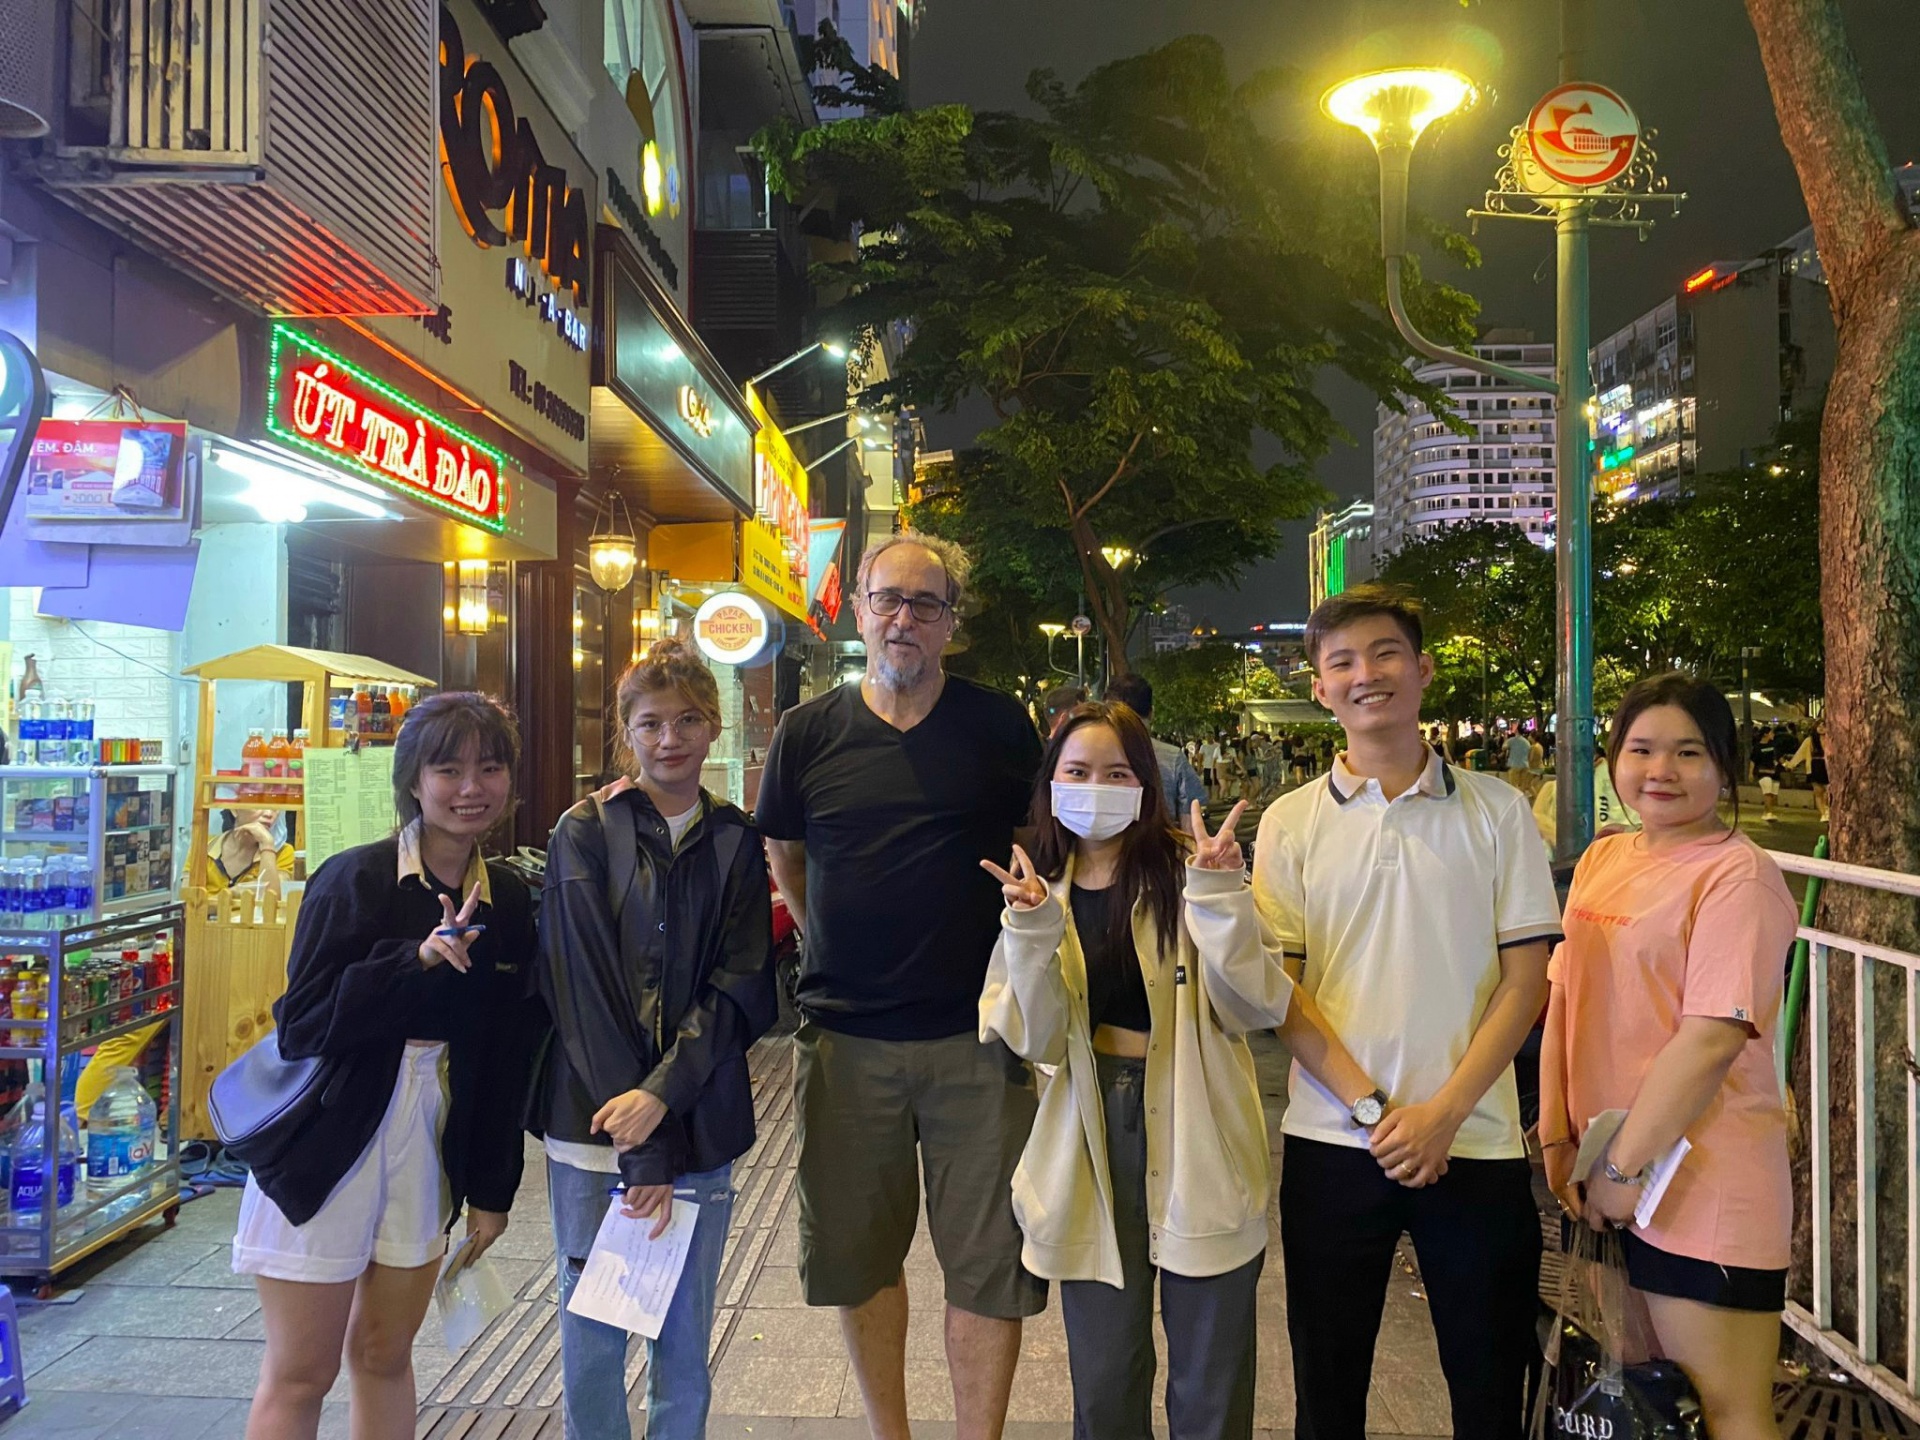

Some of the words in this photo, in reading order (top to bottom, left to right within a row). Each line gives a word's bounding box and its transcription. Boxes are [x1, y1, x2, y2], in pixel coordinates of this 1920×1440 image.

[360, 408, 429, 488] TRÀ
[432, 445, 491, 512] ĐÀO
[716, 608, 745, 619] PAPAS
[708, 622, 753, 634] CHICKEN
